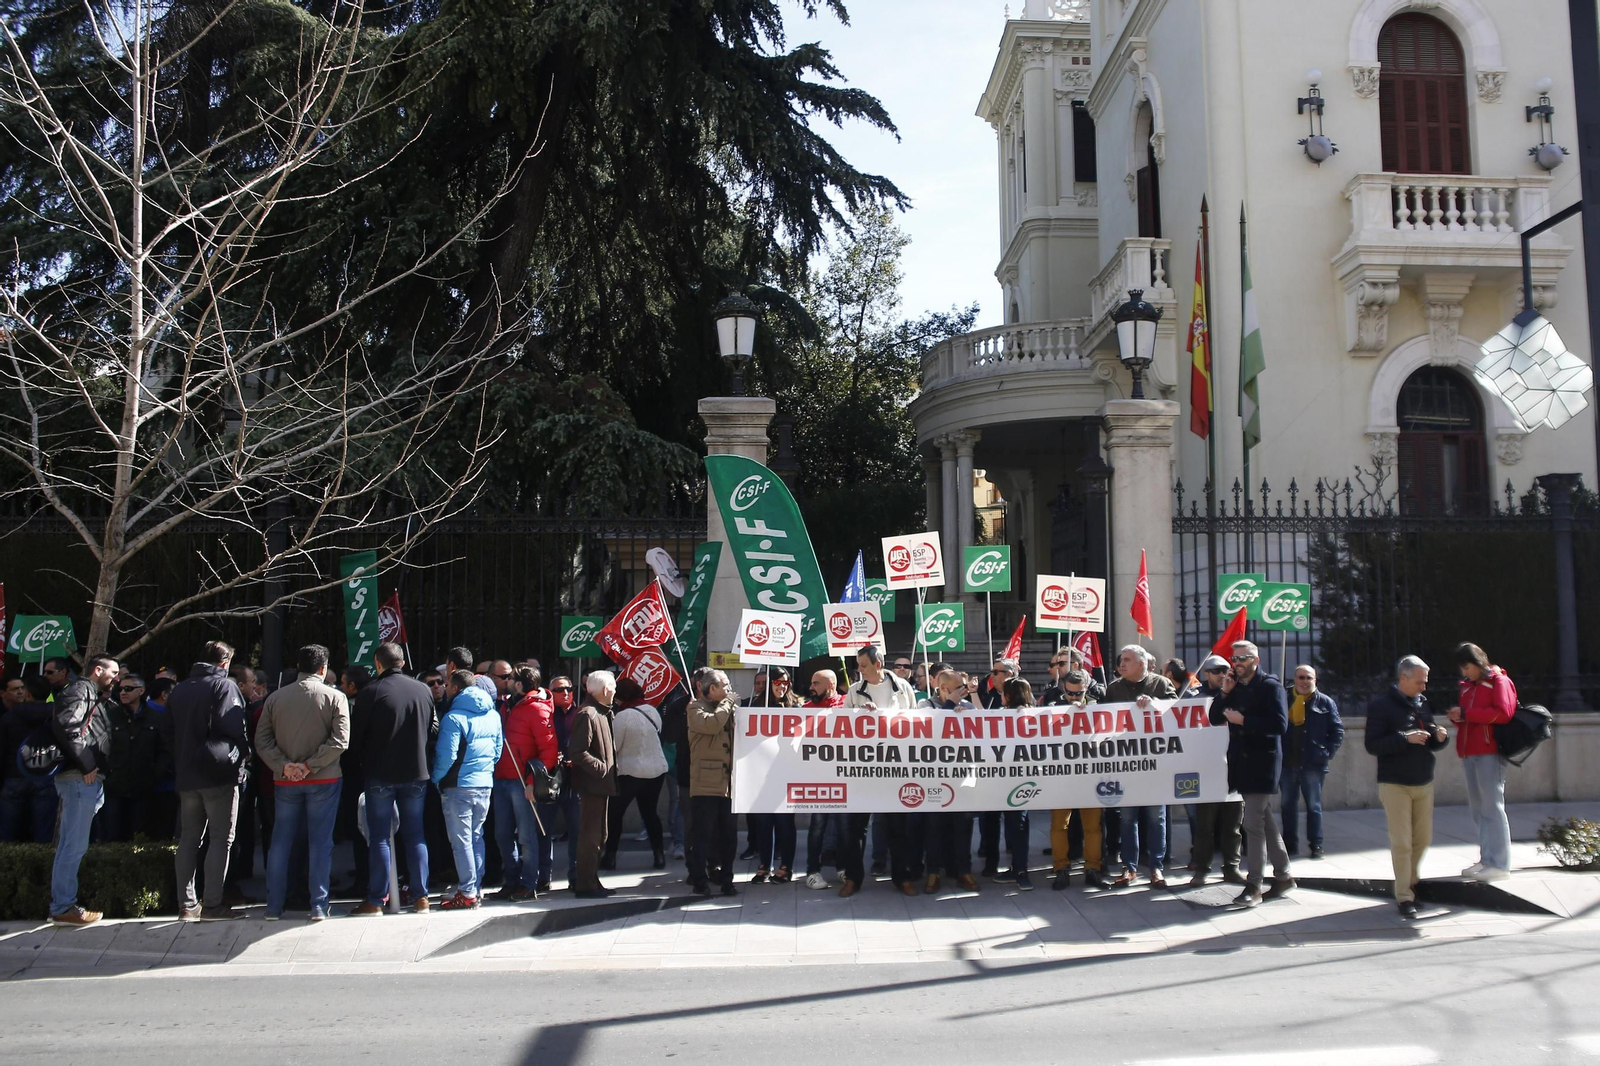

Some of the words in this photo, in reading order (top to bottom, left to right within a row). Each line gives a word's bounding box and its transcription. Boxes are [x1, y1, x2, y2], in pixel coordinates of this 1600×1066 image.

[745, 712, 933, 739] JUBILACIÓN
[941, 709, 1137, 739] ANTICIPADA
[802, 742, 902, 763] POLICÍA
[908, 745, 986, 763] LOCAL
[991, 745, 1007, 763] Y
[1013, 736, 1184, 763] AUTONÓMICA
[836, 765, 909, 779] PLATAFORMA
[911, 766, 935, 779] POR
[938, 767, 949, 779] EL
[952, 765, 1007, 779] ANTICIPO
[1009, 765, 1024, 777] DE
[1026, 765, 1040, 777] LA
[1042, 763, 1072, 776] EDAD
[1074, 763, 1089, 775] DE
[1091, 758, 1157, 774] JUBILACIÓN
[791, 786, 843, 800] CCOO
[1096, 781, 1124, 797] CSL
[1176, 779, 1200, 790] COP
